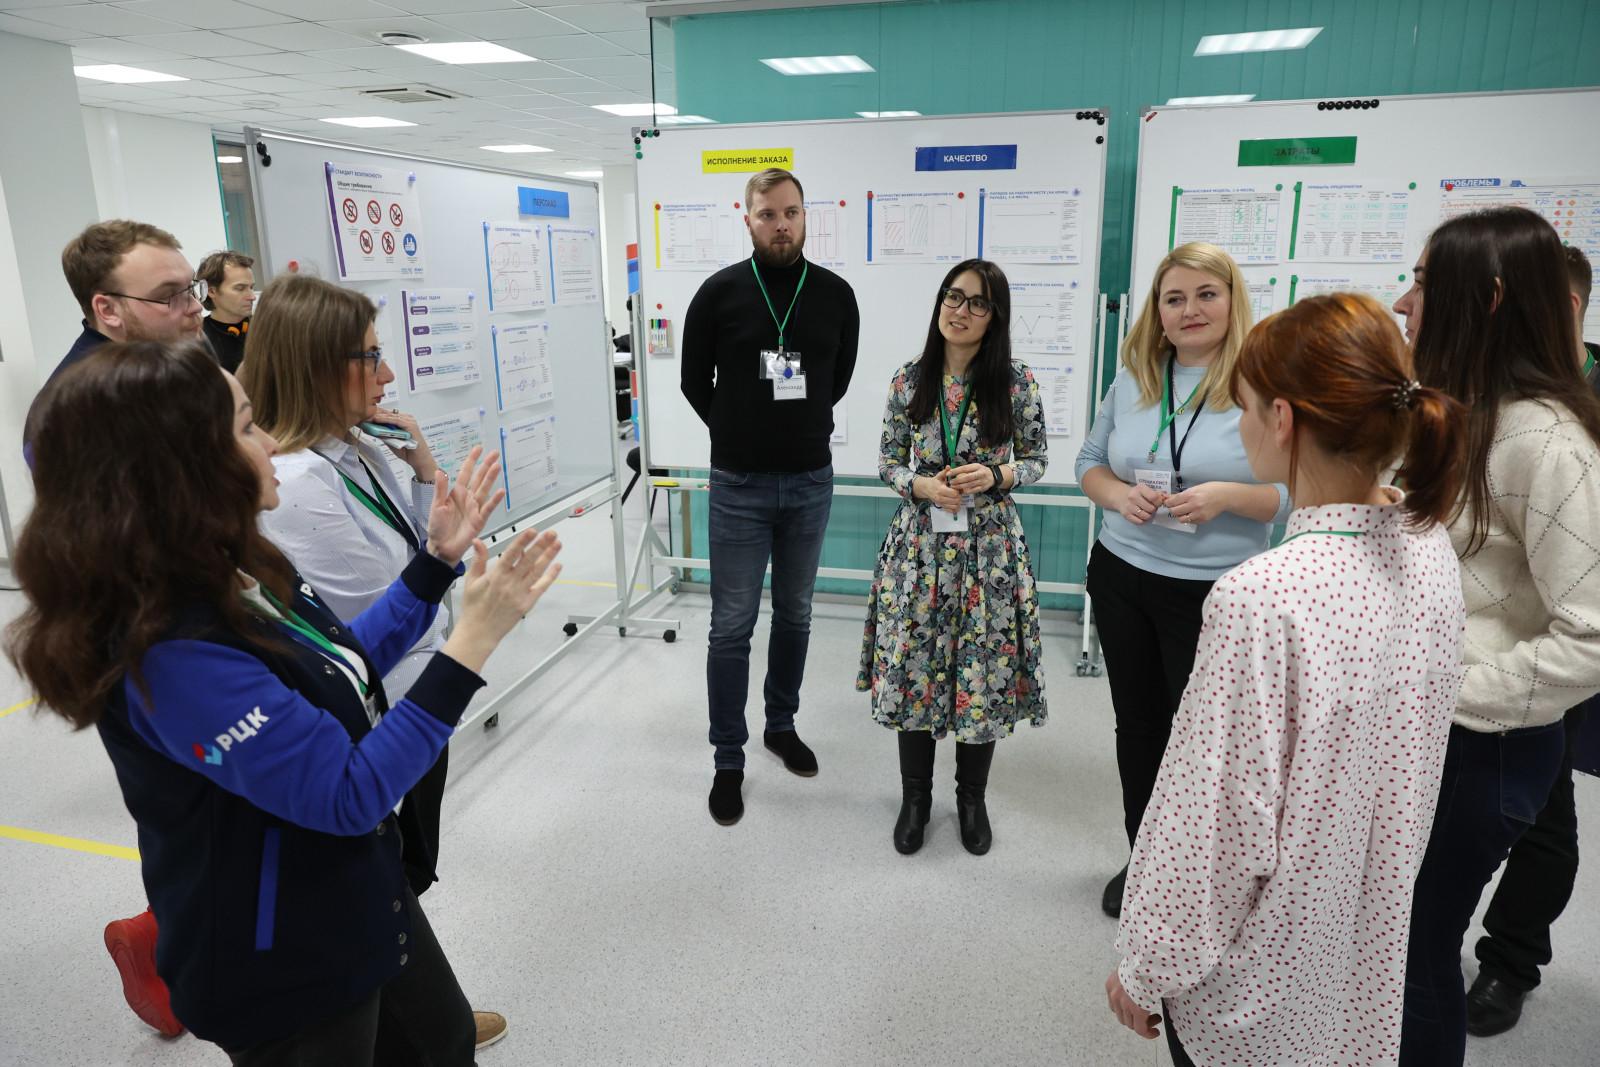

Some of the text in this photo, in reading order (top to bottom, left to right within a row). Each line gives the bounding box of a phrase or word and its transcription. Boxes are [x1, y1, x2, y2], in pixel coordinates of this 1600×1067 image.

[706, 157, 757, 165] ИСПОЛНЕНИЕ
[943, 154, 988, 163] КАЧЕСТВО
[215, 705, 270, 752] РЦК
